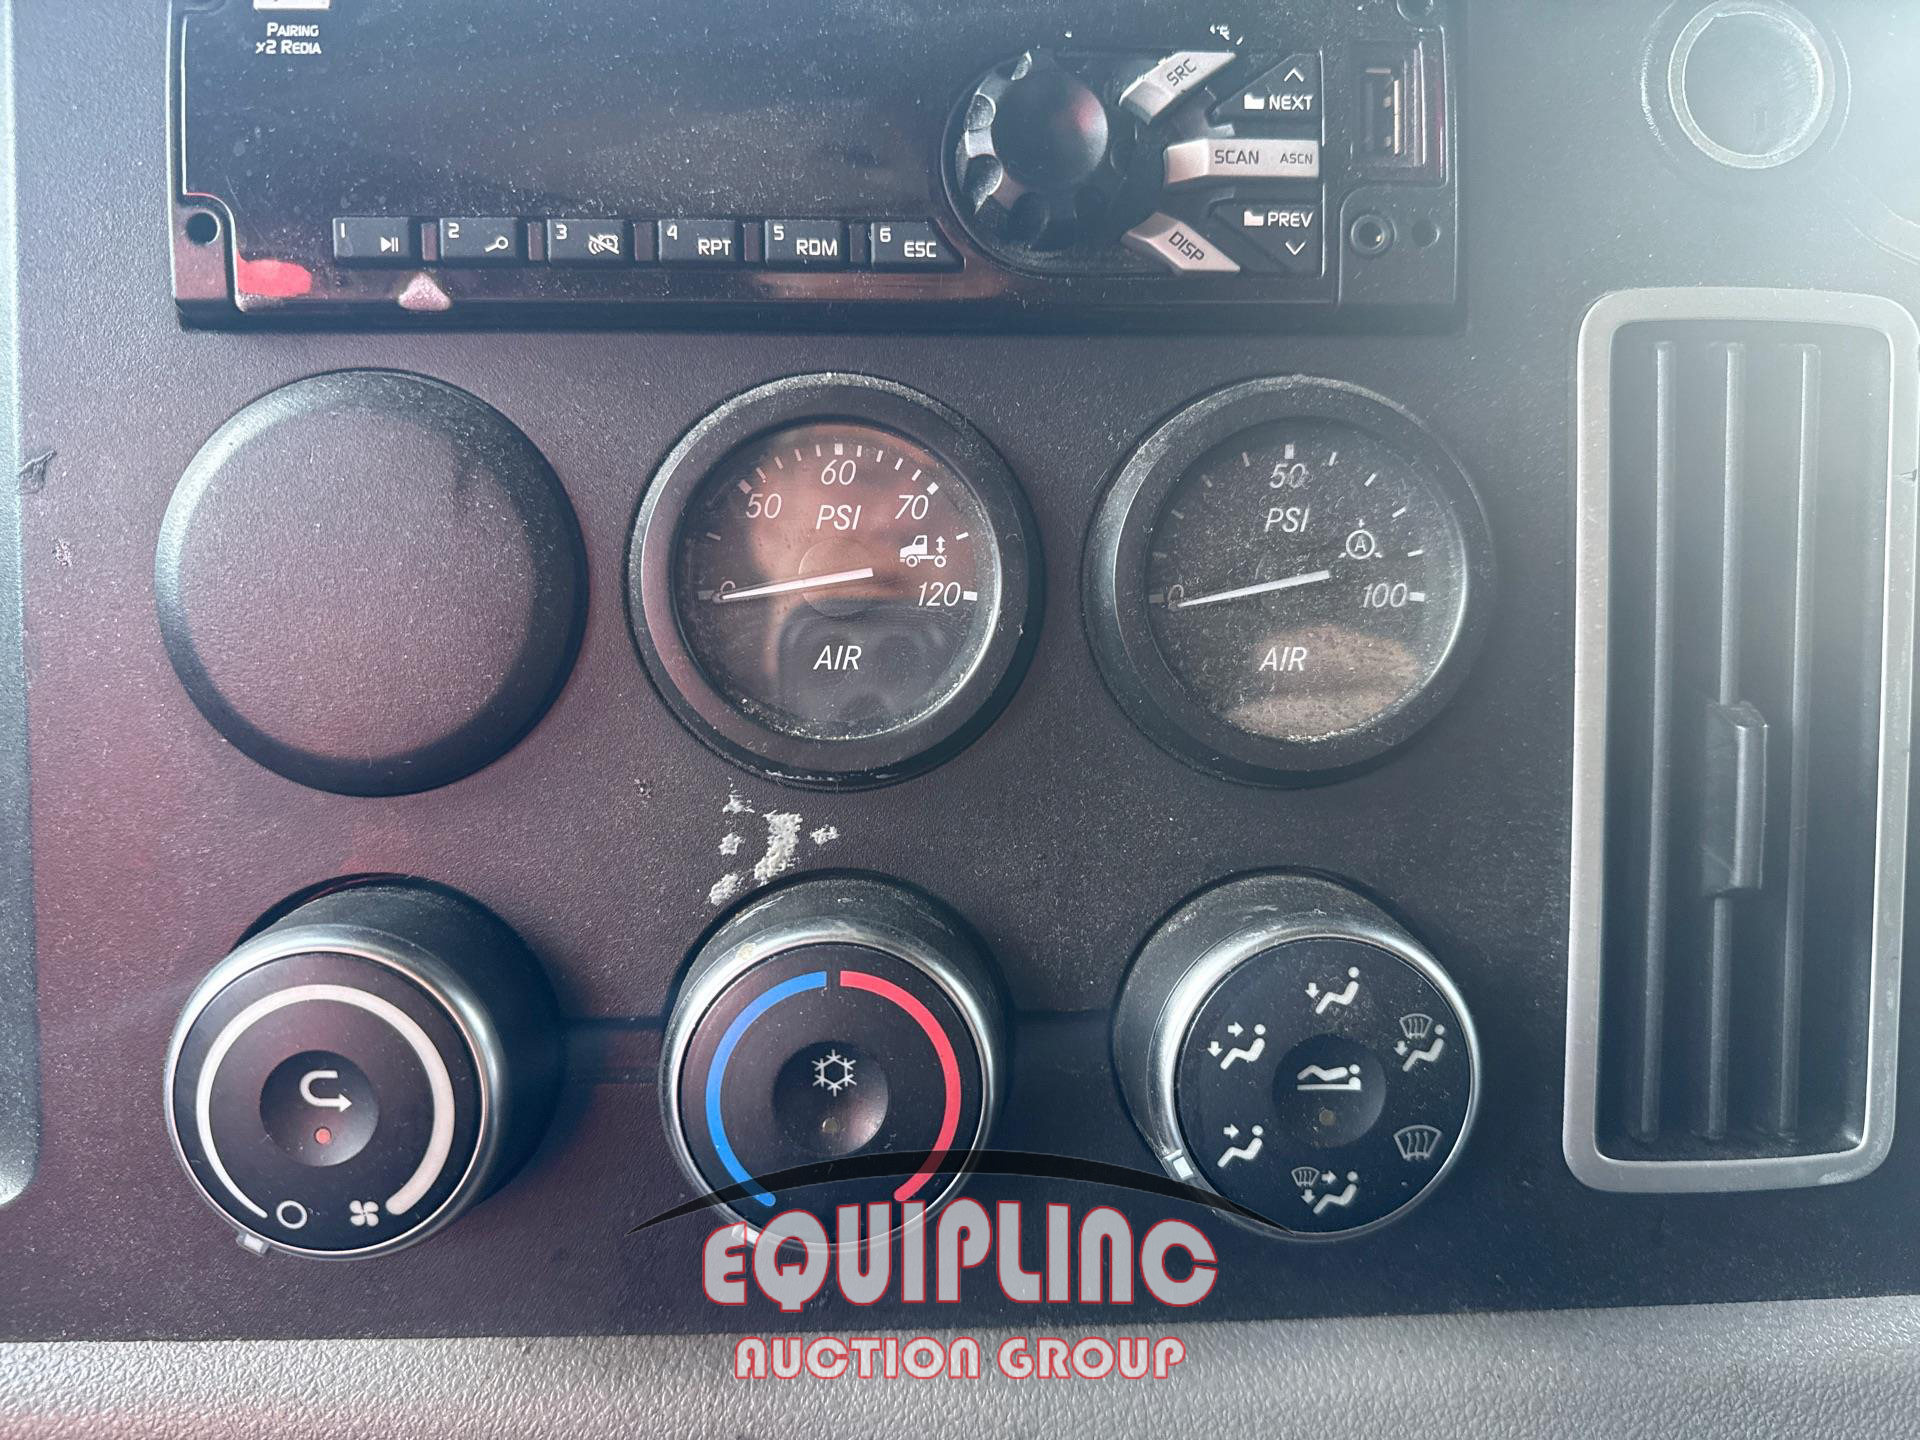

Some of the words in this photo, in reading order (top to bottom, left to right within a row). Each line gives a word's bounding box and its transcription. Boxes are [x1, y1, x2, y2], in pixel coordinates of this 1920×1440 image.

[1166, 58, 1197, 86] SRC
[1269, 95, 1313, 111] NEXT
[1214, 150, 1259, 165] SCAN
[1279, 152, 1313, 165] ASCN
[448, 223, 460, 238] 2
[556, 224, 568, 239] 3
[1267, 212, 1313, 228] PREV
[666, 225, 678, 240] 4
[773, 225, 785, 241] 5
[879, 227, 891, 243] 6
[698, 239, 732, 256] RPT
[796, 239, 838, 256] RDM
[904, 241, 937, 258] ESC
[1168, 231, 1205, 261] DISP
[821, 459, 856, 486] 60
[1269, 463, 1307, 489] 50
[745, 493, 782, 519] 50
[815, 504, 862, 530] PSI
[894, 494, 929, 521] 70
[1264, 508, 1309, 532] PSI
[917, 581, 961, 607] 120
[1362, 583, 1408, 608] 100
[813, 645, 862, 670] AIR
[1259, 646, 1307, 671] AIR
